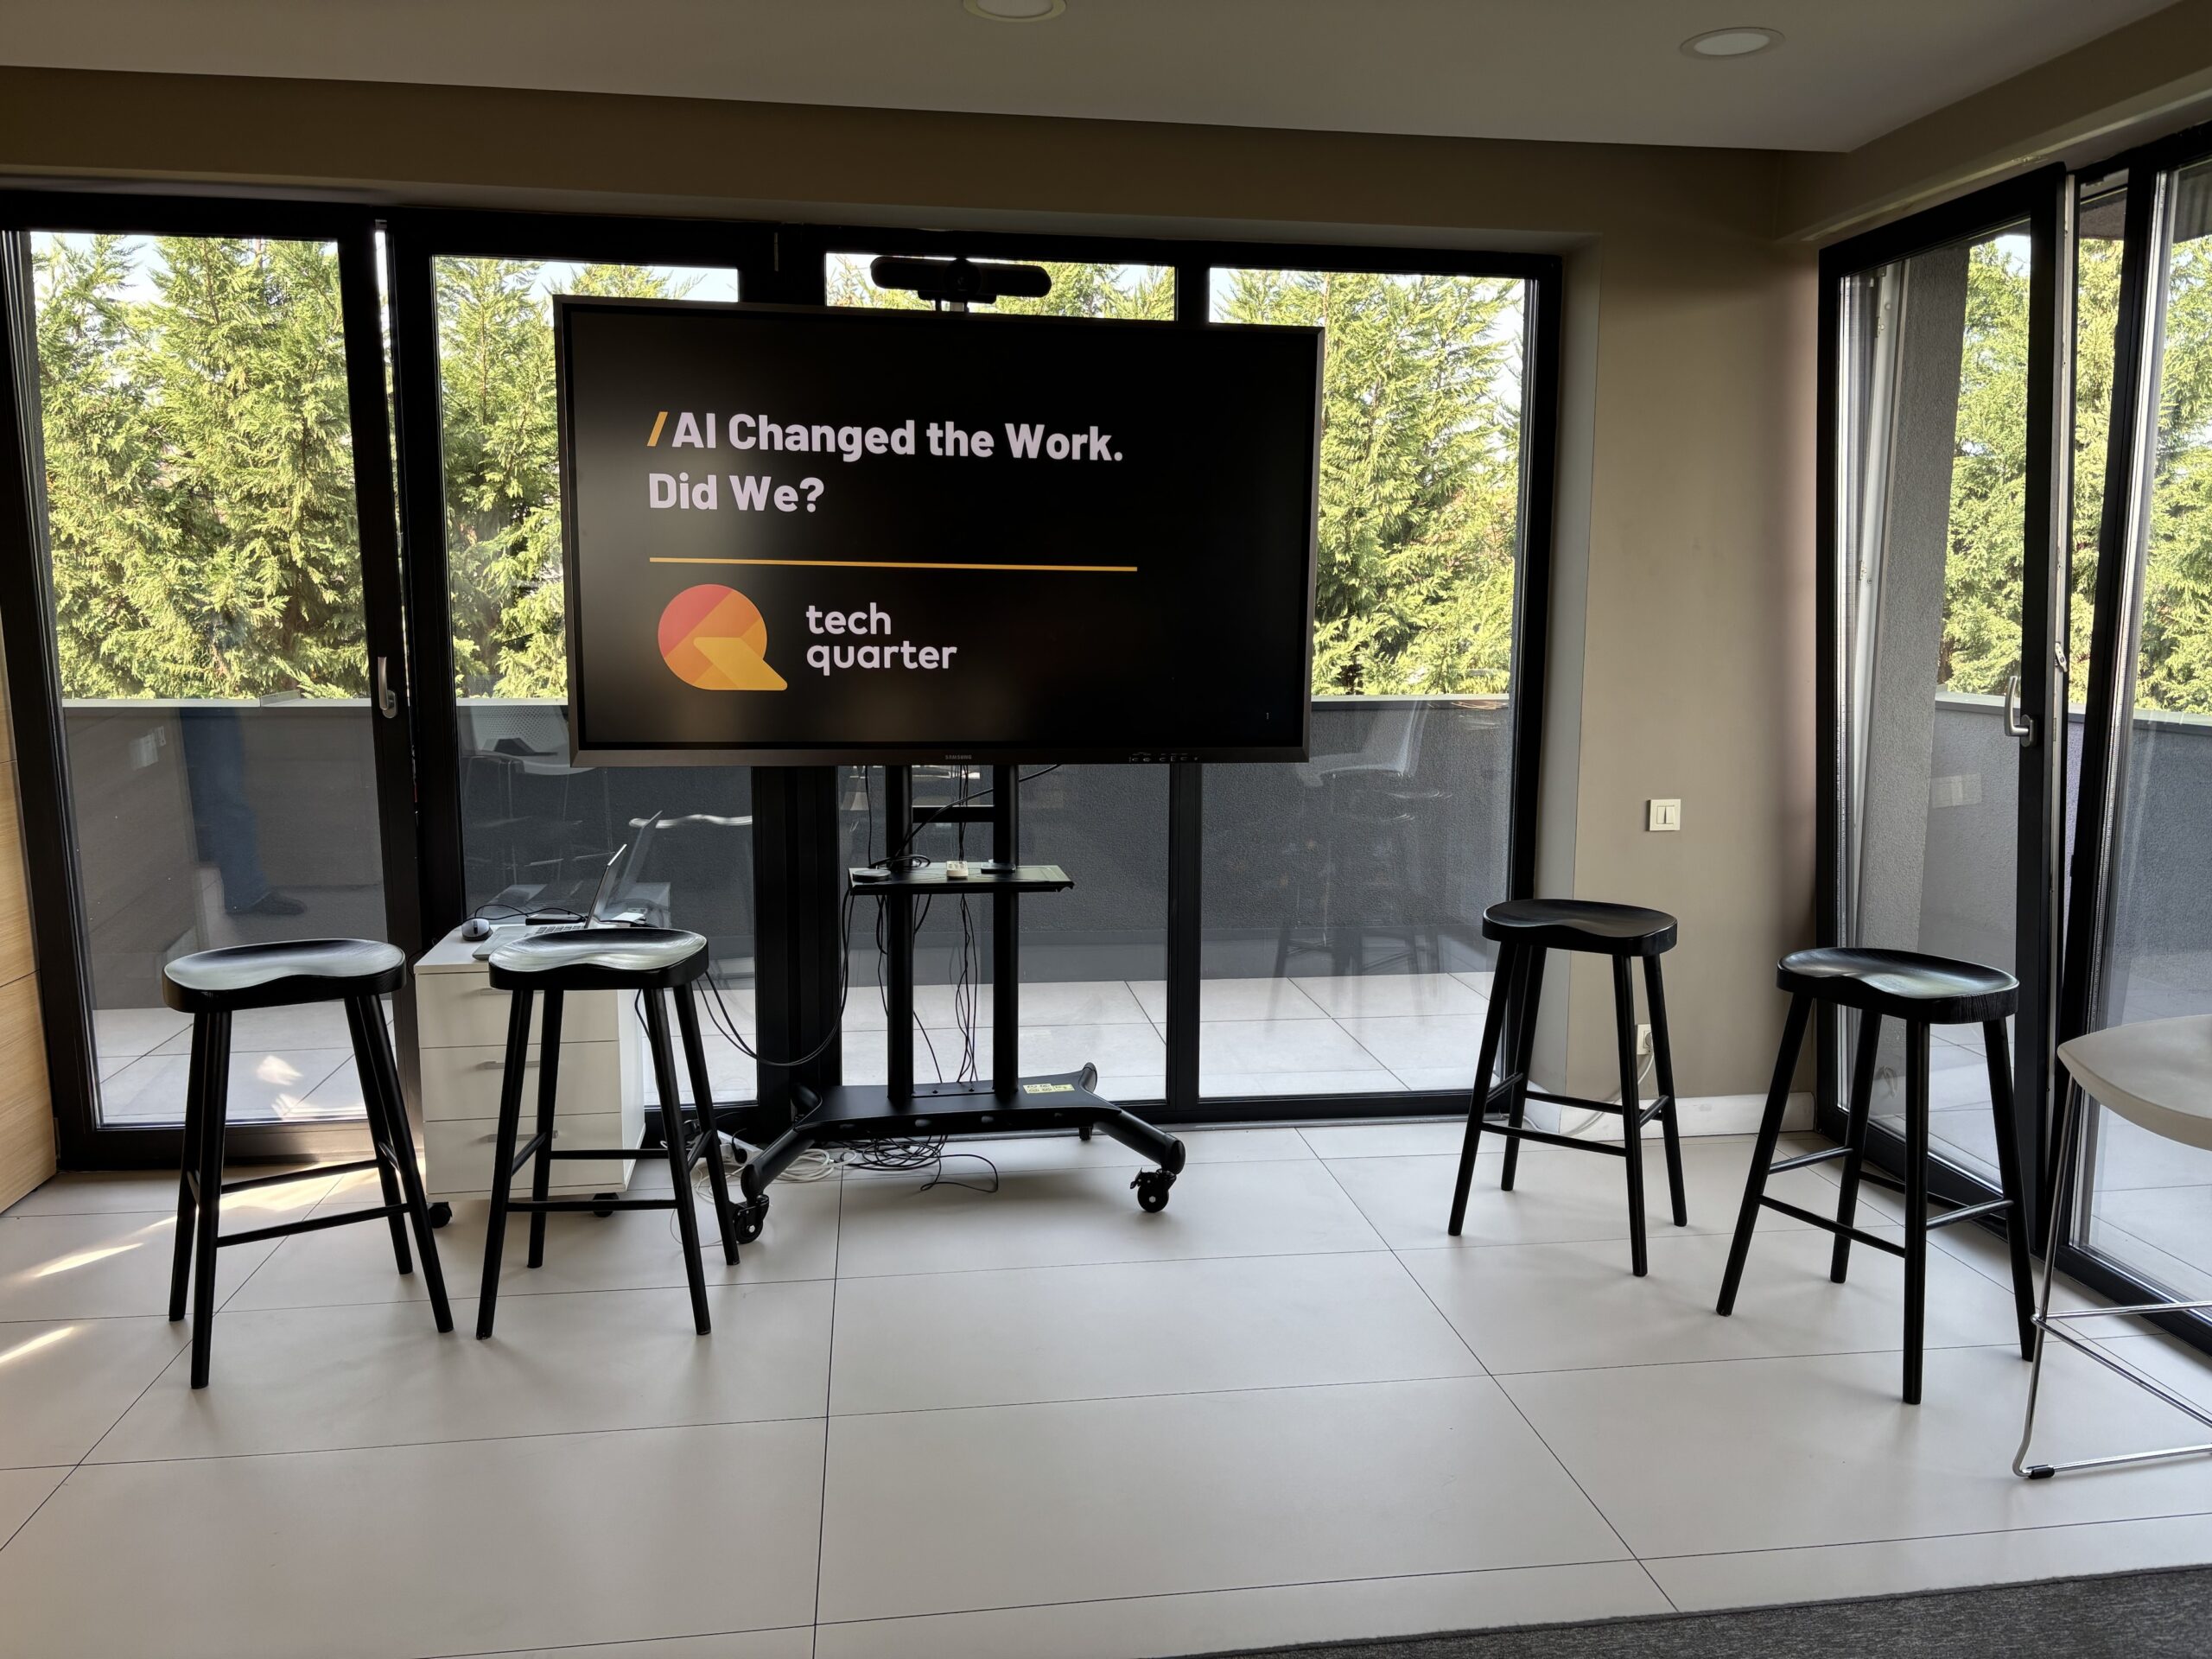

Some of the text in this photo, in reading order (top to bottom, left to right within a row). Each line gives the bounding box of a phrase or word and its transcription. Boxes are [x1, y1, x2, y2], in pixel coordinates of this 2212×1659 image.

[728, 413, 915, 462] Changed
[926, 421, 995, 457] the
[1005, 423, 1123, 461] Work.
[648, 472, 824, 512] Did We?
[805, 602, 892, 635] tech
[806, 640, 957, 676] quarter
